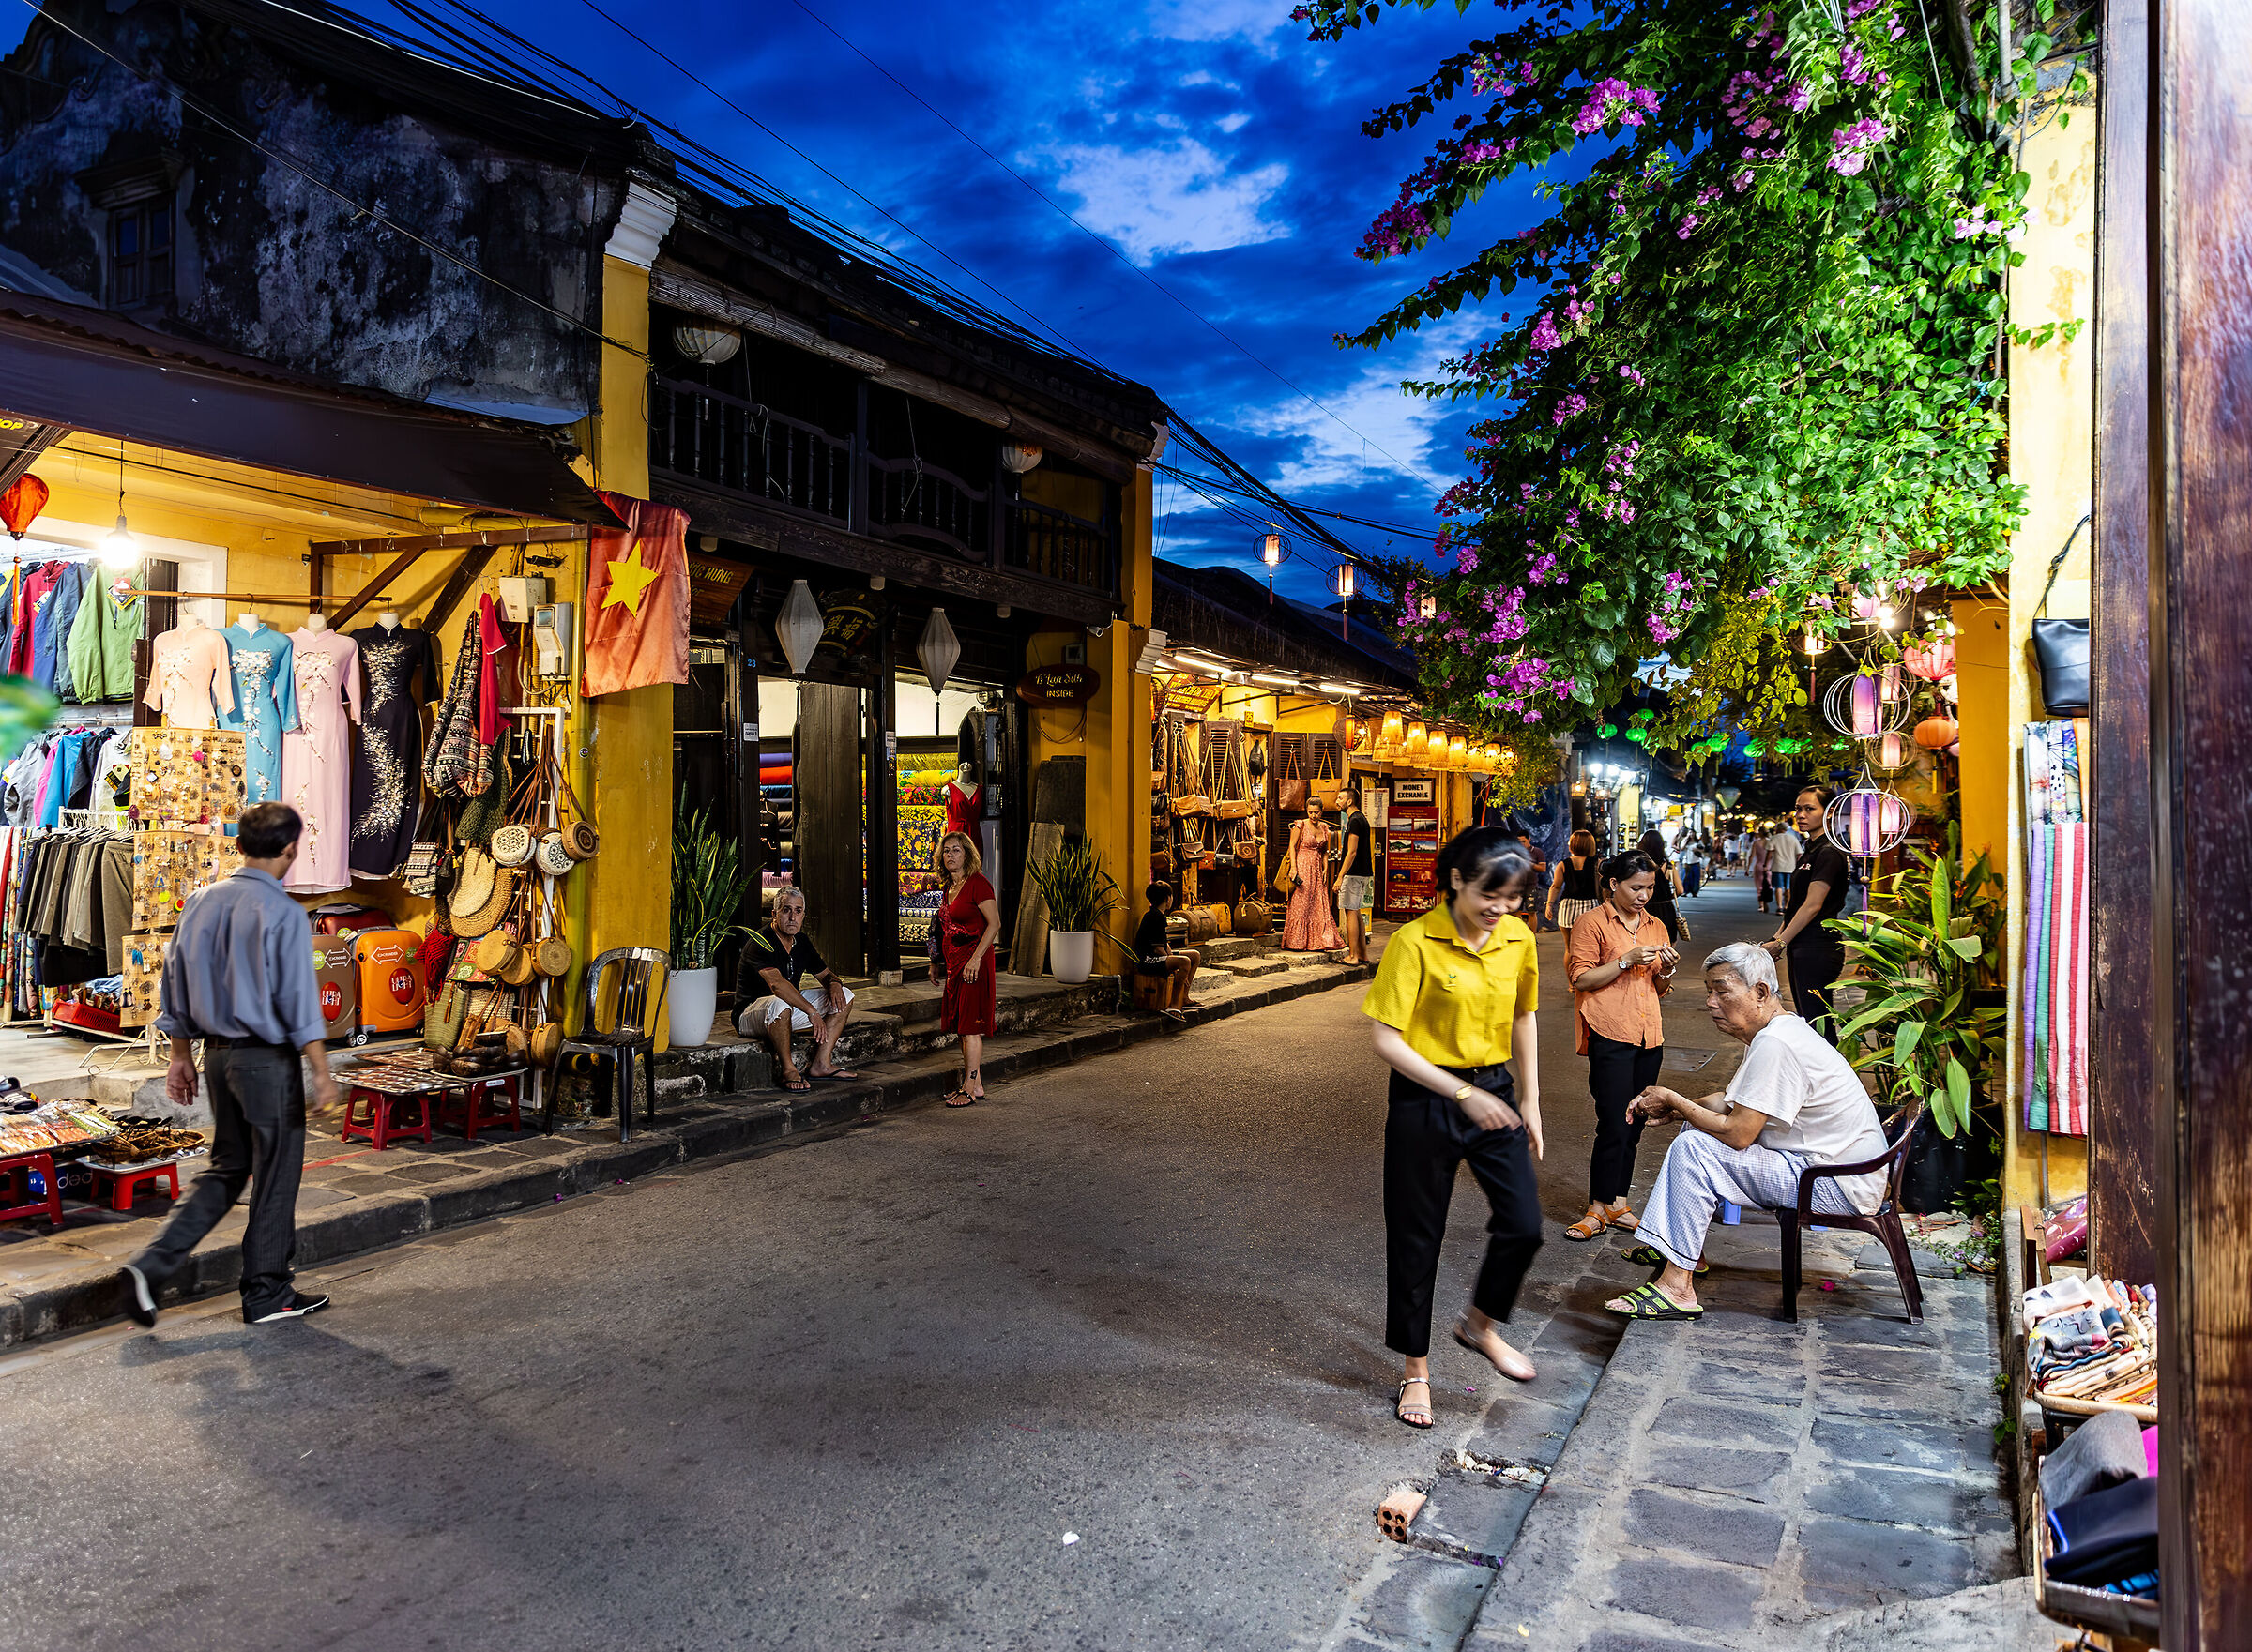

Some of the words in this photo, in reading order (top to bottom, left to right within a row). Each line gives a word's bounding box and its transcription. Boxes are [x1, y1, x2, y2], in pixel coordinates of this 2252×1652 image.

[0, 418, 23, 431] OP
[747, 659, 756, 668] 23
[1046, 689, 1074, 698] INSIDE
